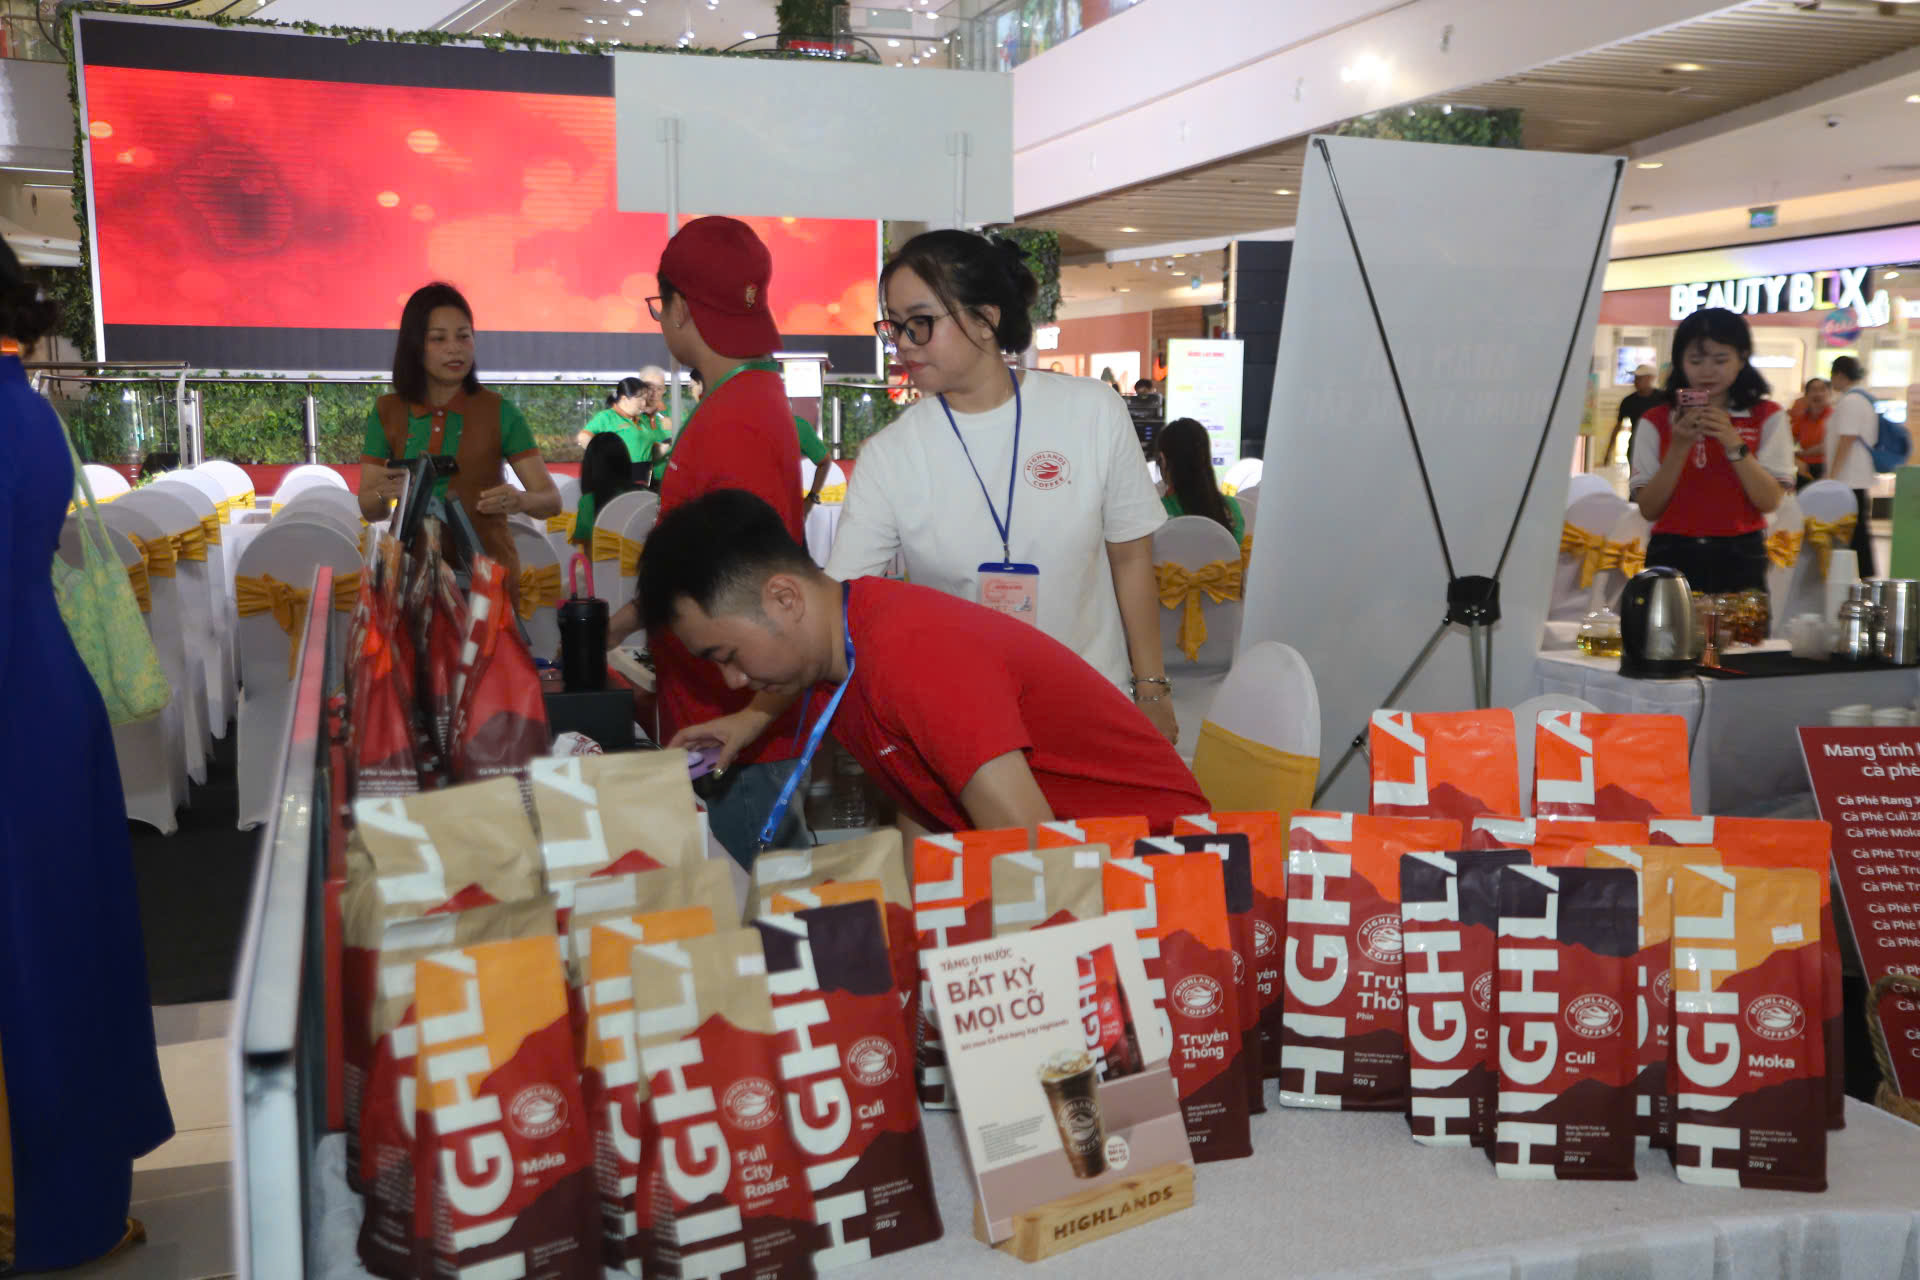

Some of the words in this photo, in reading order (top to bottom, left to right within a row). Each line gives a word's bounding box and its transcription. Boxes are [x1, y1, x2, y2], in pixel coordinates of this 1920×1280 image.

[1670, 274, 1787, 320] BEAUTY
[1026, 453, 1067, 471] HIGHLANDS
[1033, 476, 1064, 489] COFFEE
[1823, 744, 1876, 761] Mang
[1862, 762, 1885, 777] cà
[1838, 795, 1855, 806] Cà
[1856, 795, 1879, 806] Phê
[1880, 796, 1913, 808] Rang
[1842, 811, 1860, 822] Cà
[1886, 811, 1909, 821] Culi
[1847, 827, 1865, 838] Cà
[1853, 848, 1870, 859] Cà
[1858, 865, 1875, 876] Cà
[1863, 882, 1880, 892] Cà
[1869, 903, 1886, 914] Cà
[1362, 916, 1401, 936] HIGHLA
[1873, 920, 1891, 931] Cà
[1879, 937, 1897, 948] Cà
[1256, 968, 1278, 983] yền
[1887, 964, 1904, 976] Cà
[947, 966, 996, 1004] BẤT
[1002, 957, 1036, 991] KỲ
[1176, 977, 1220, 997] HIGHLANDS
[1358, 971, 1403, 989] Tru
[1357, 990, 1404, 1010] Thố
[1569, 996, 1619, 1015] HIGHLANDS
[1750, 997, 1801, 1016] HIGHLANDS
[954, 1003, 1005, 1035] MỌI
[1010, 987, 1045, 1020] CỠ
[1183, 1005, 1217, 1017] COFFEE
[1574, 1025, 1614, 1037] COFFEE
[1756, 1026, 1797, 1039] COFFEE
[850, 1040, 892, 1063] HIGHLANDS
[1565, 1051, 1596, 1065] Culi
[1748, 1053, 1796, 1069] Moka
[859, 1067, 892, 1084] COFFEE
[1353, 1077, 1370, 1087] 500
[858, 1100, 885, 1119] Culi
[738, 1144, 767, 1165] Full
[521, 1153, 567, 1176] Moka
[742, 1163, 774, 1183] City
[744, 1176, 790, 1200] Roast
[1054, 1184, 1174, 1240] HIGHLANDS
